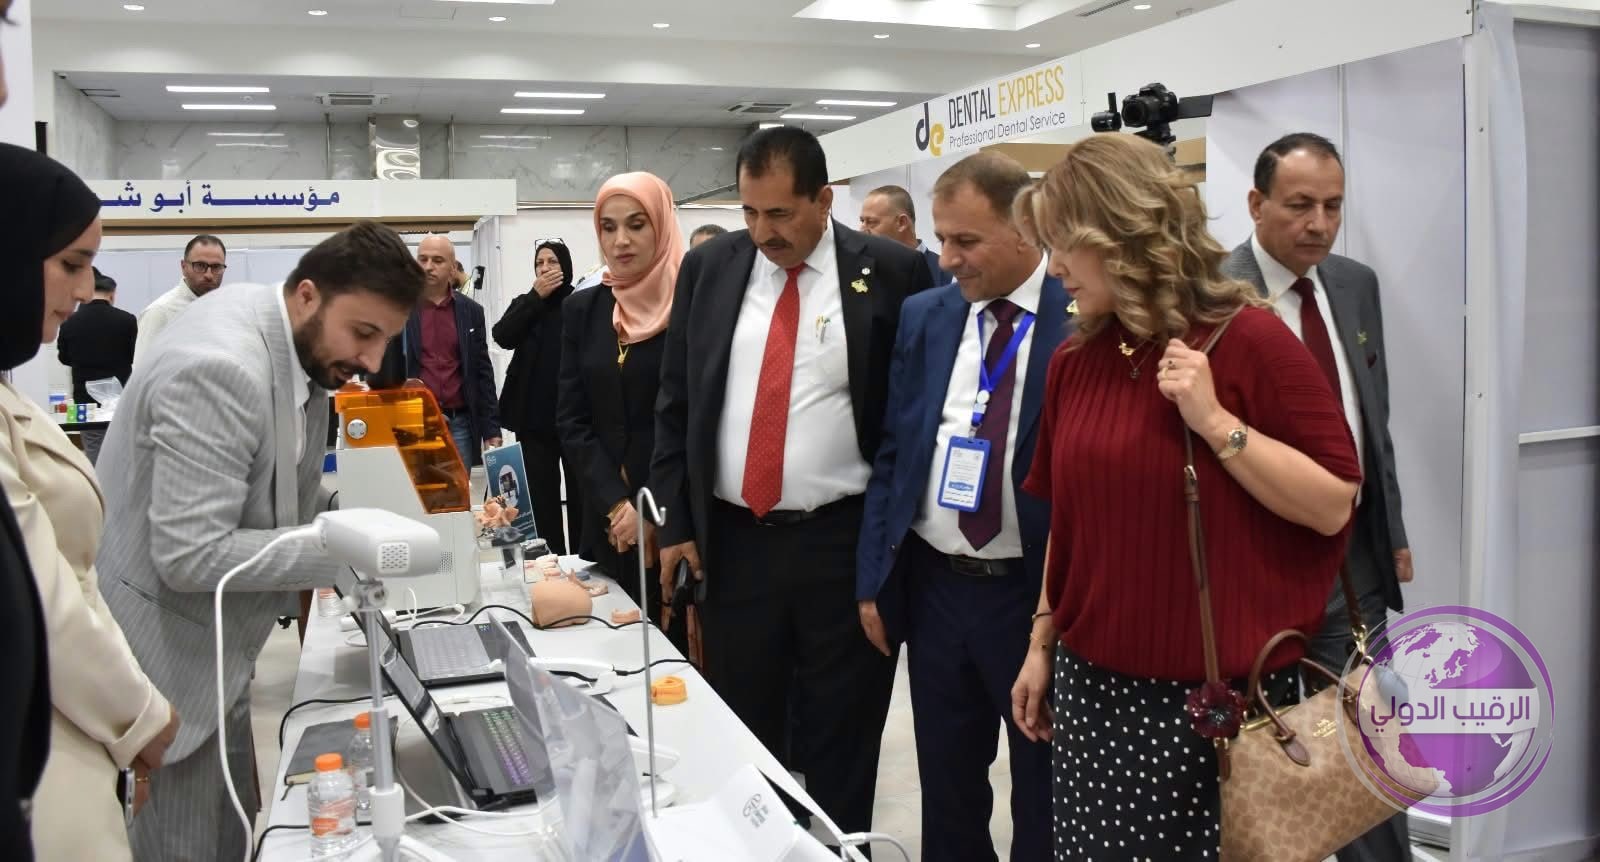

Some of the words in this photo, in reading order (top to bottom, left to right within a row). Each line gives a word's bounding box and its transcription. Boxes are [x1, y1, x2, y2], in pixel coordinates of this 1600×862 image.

[949, 87, 995, 129] DENTAL
[998, 64, 1065, 116] EXPRESS
[949, 125, 996, 149] Professional
[998, 118, 1028, 138] Dental
[1030, 111, 1066, 131] Service
[150, 180, 191, 213] أبو
[202, 184, 340, 212] مؤسسة
